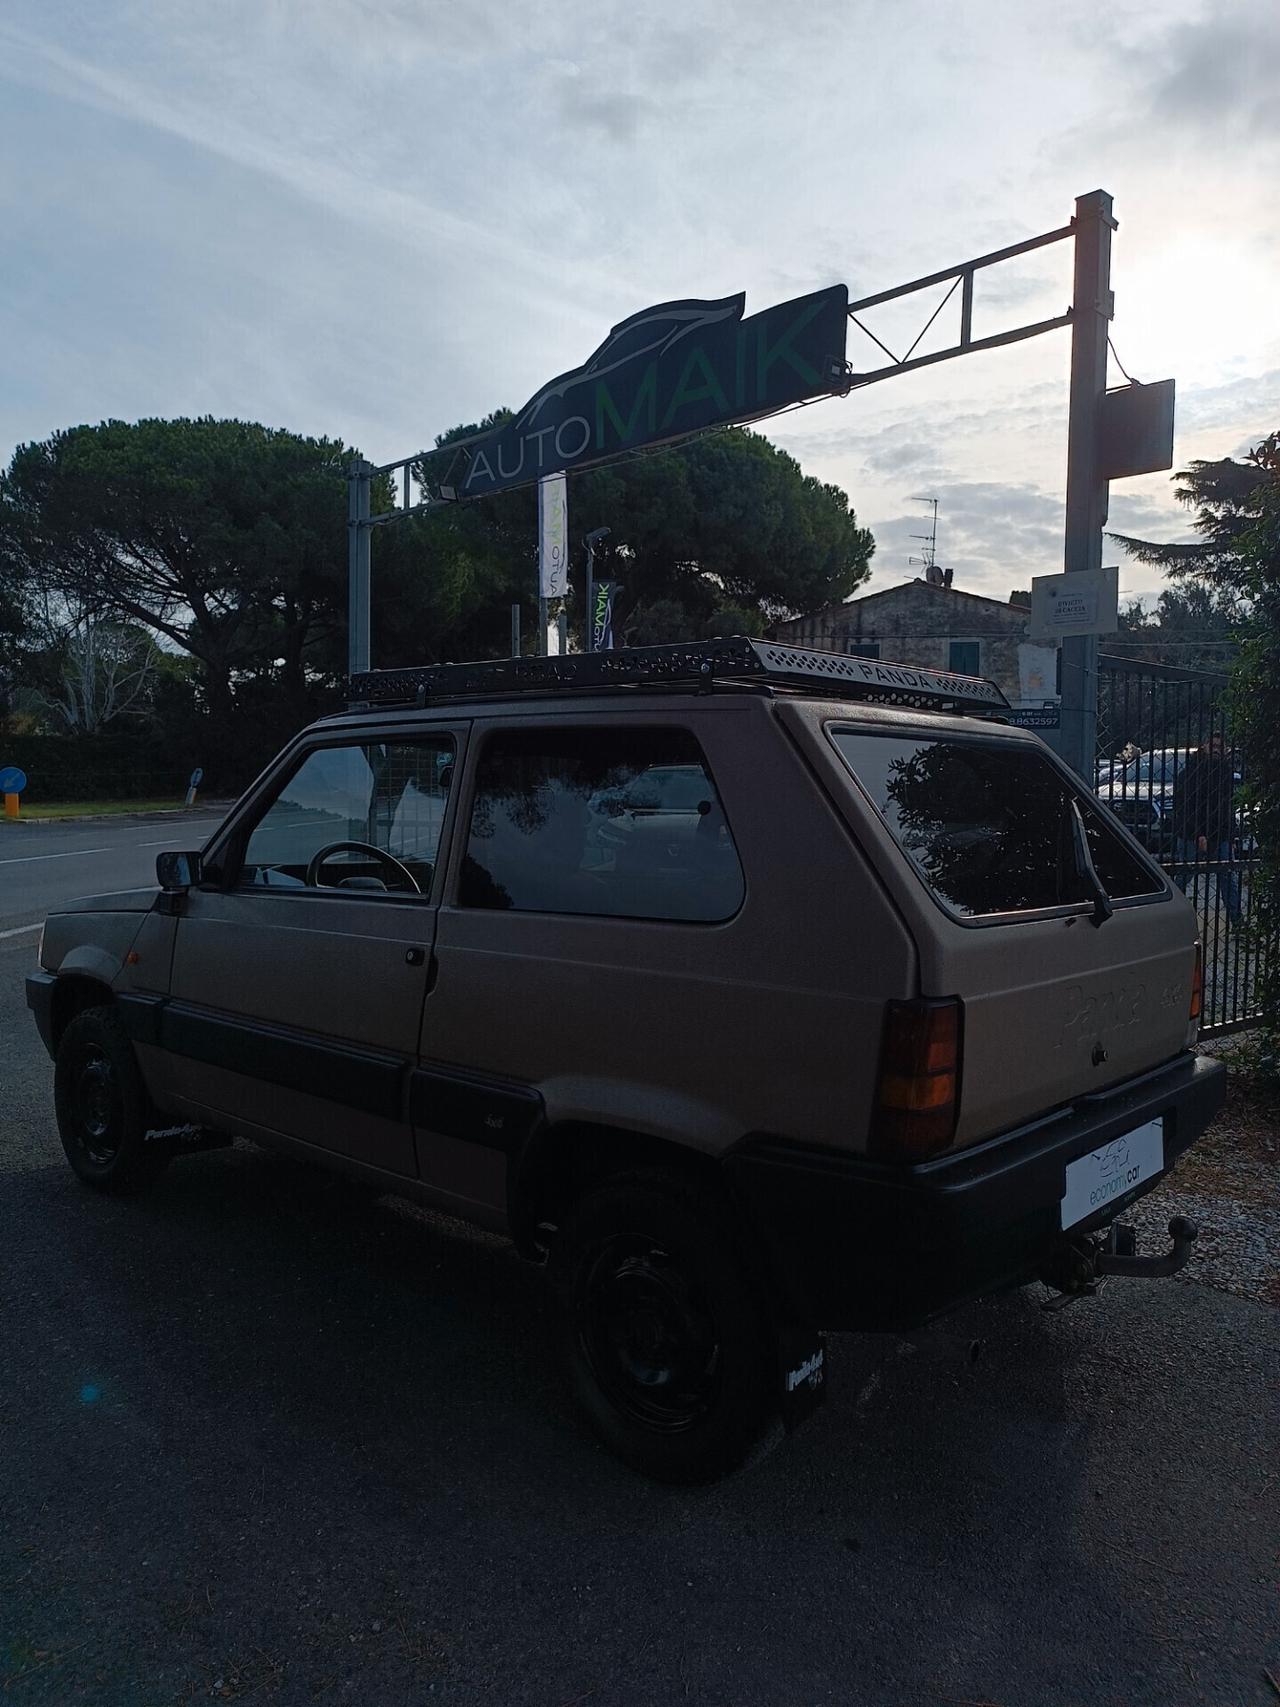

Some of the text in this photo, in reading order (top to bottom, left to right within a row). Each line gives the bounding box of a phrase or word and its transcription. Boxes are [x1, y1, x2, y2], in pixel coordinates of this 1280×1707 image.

[465, 300, 828, 489] AUTOMAIK
[859, 664, 933, 689] PANDA
[1009, 717, 1058, 726] 8.8632597
